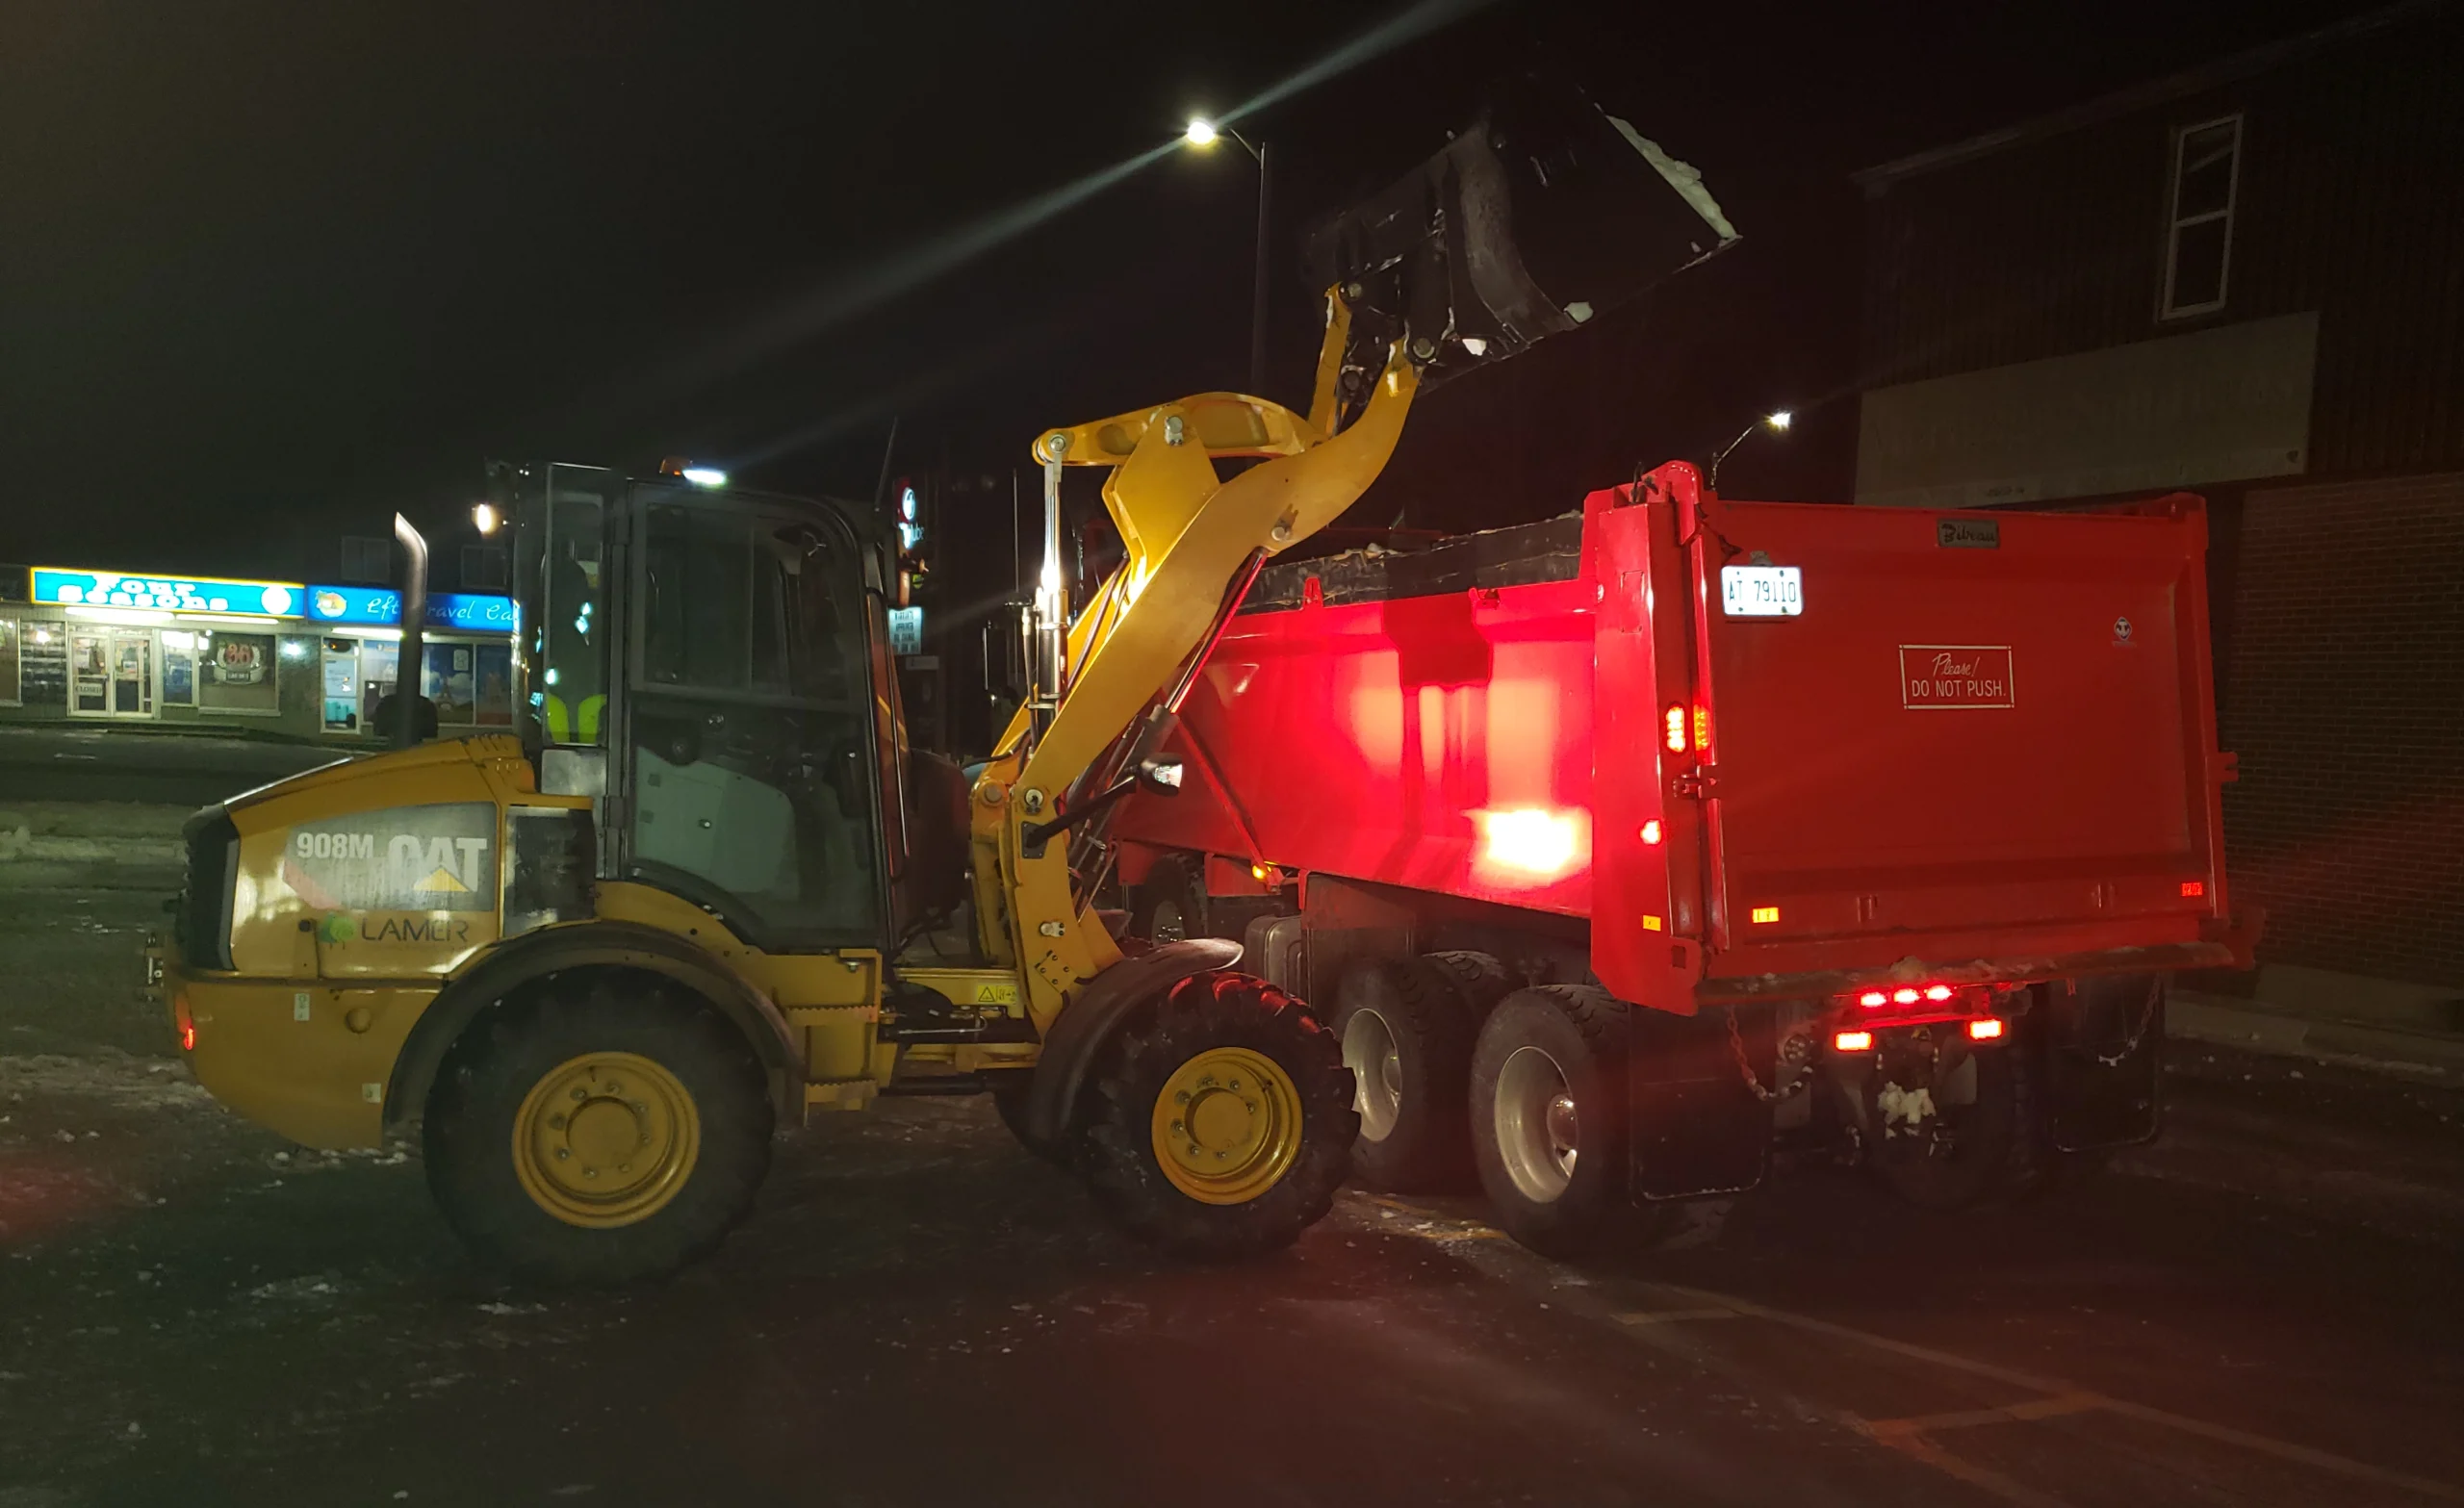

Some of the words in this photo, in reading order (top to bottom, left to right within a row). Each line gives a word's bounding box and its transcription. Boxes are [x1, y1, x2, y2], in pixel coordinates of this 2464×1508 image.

[1729, 580, 1743, 601] AT
[1754, 579, 1797, 602] 79110
[425, 601, 475, 620] ravel
[1932, 652, 1980, 677] Please!
[1912, 679, 1930, 697] DO
[1936, 679, 1962, 697] NOT
[1966, 679, 2007, 697] PUSH.
[296, 832, 374, 859] 908M
[388, 834, 487, 895] CAT
